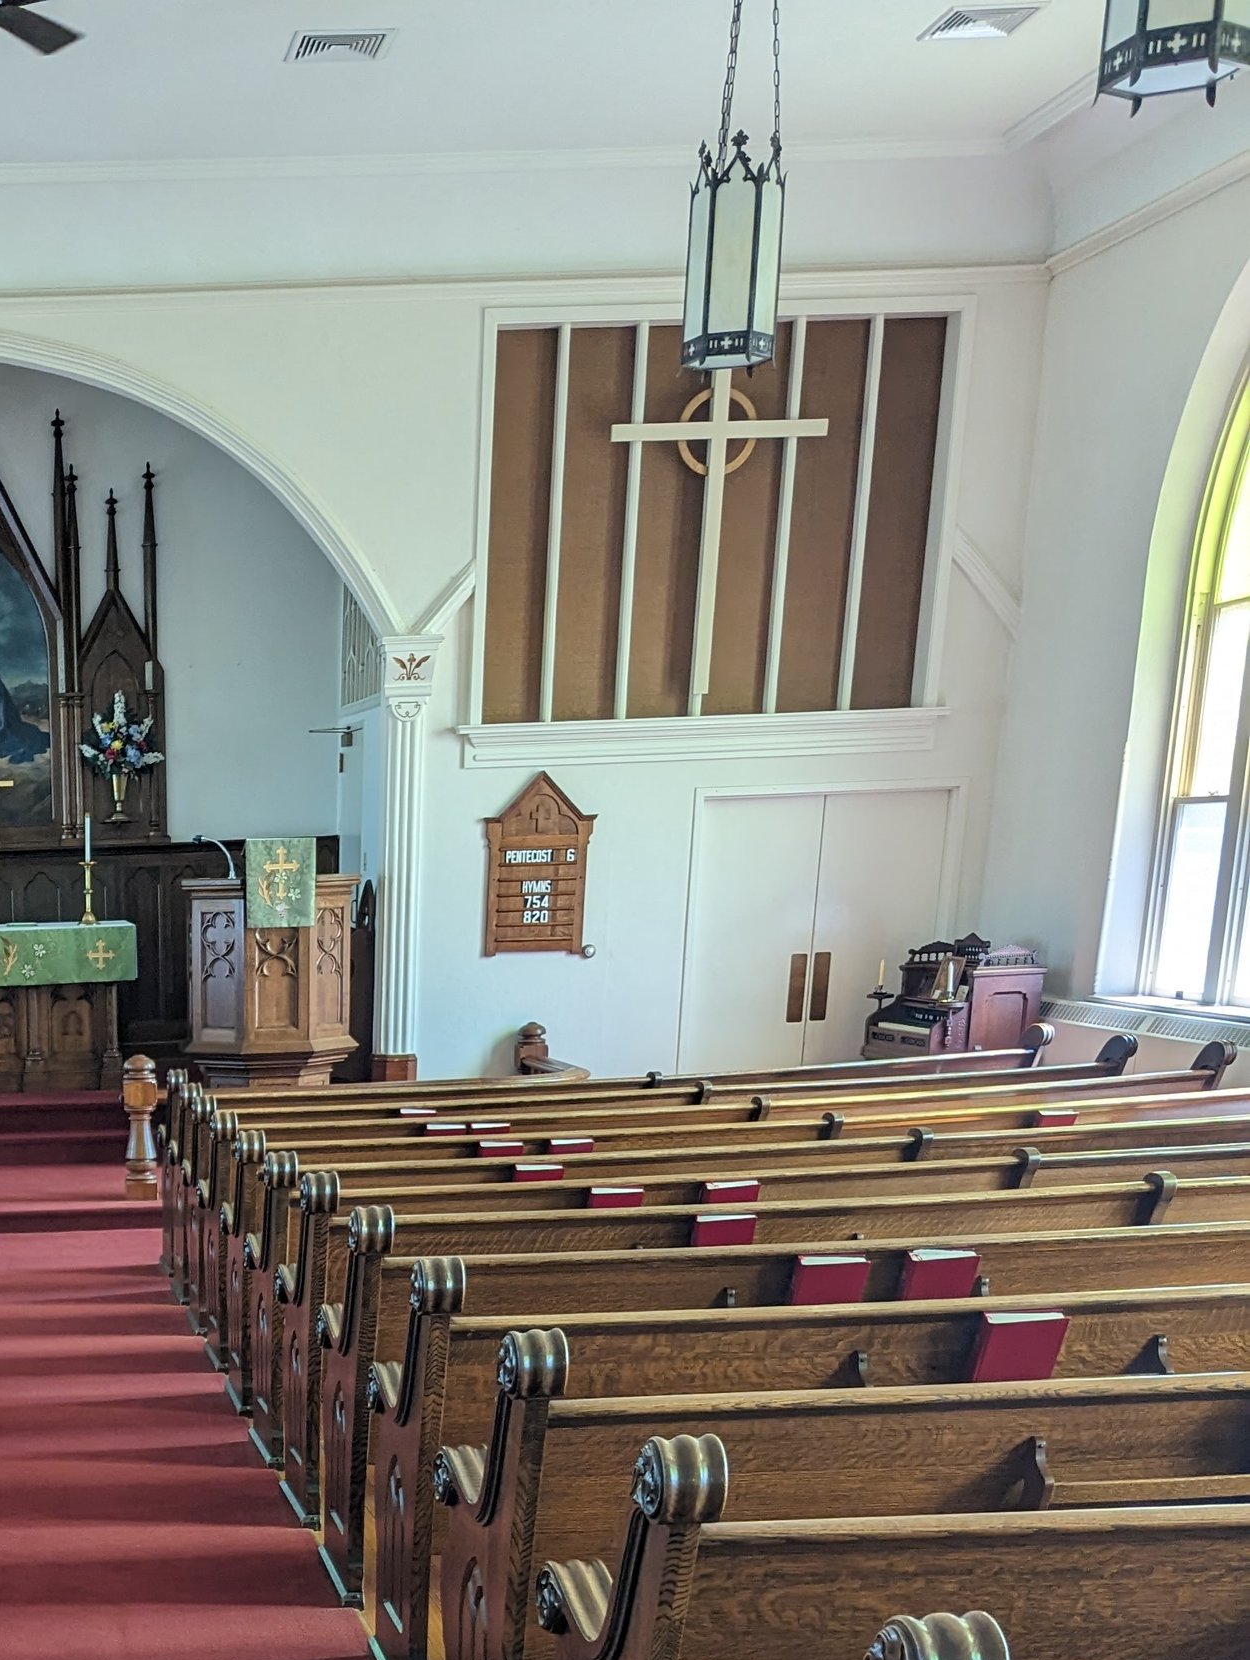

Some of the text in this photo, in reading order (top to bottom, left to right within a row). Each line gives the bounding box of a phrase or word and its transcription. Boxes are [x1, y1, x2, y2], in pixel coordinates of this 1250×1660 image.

[505, 848, 576, 864] PENTECOST 6
[522, 880, 552, 894] HYMNS
[524, 895, 549, 909] 754
[523, 910, 549, 924] 820
